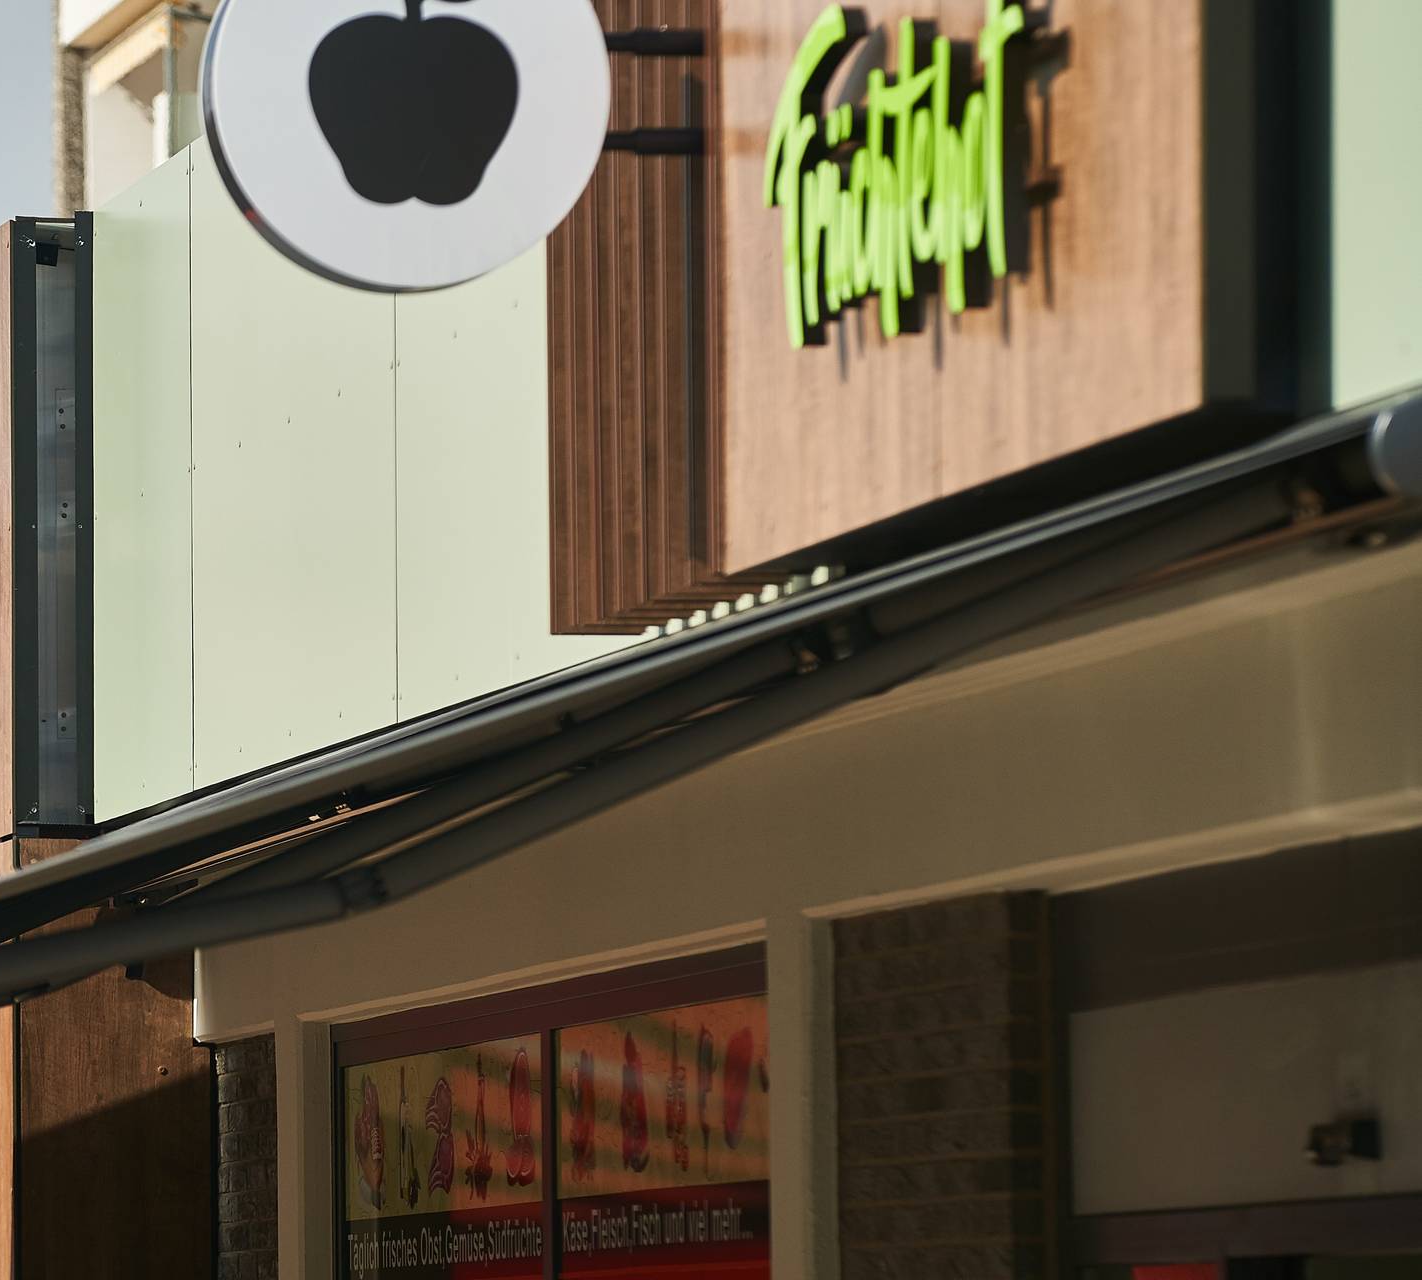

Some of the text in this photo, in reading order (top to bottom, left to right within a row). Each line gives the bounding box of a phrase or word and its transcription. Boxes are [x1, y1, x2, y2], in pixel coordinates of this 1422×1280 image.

[764, 0, 1024, 349] Früchtehof
[348, 1233, 380, 1279] Täglich
[382, 1230, 418, 1268] frisches
[663, 1201, 686, 1243] und
[688, 1199, 709, 1242] viel
